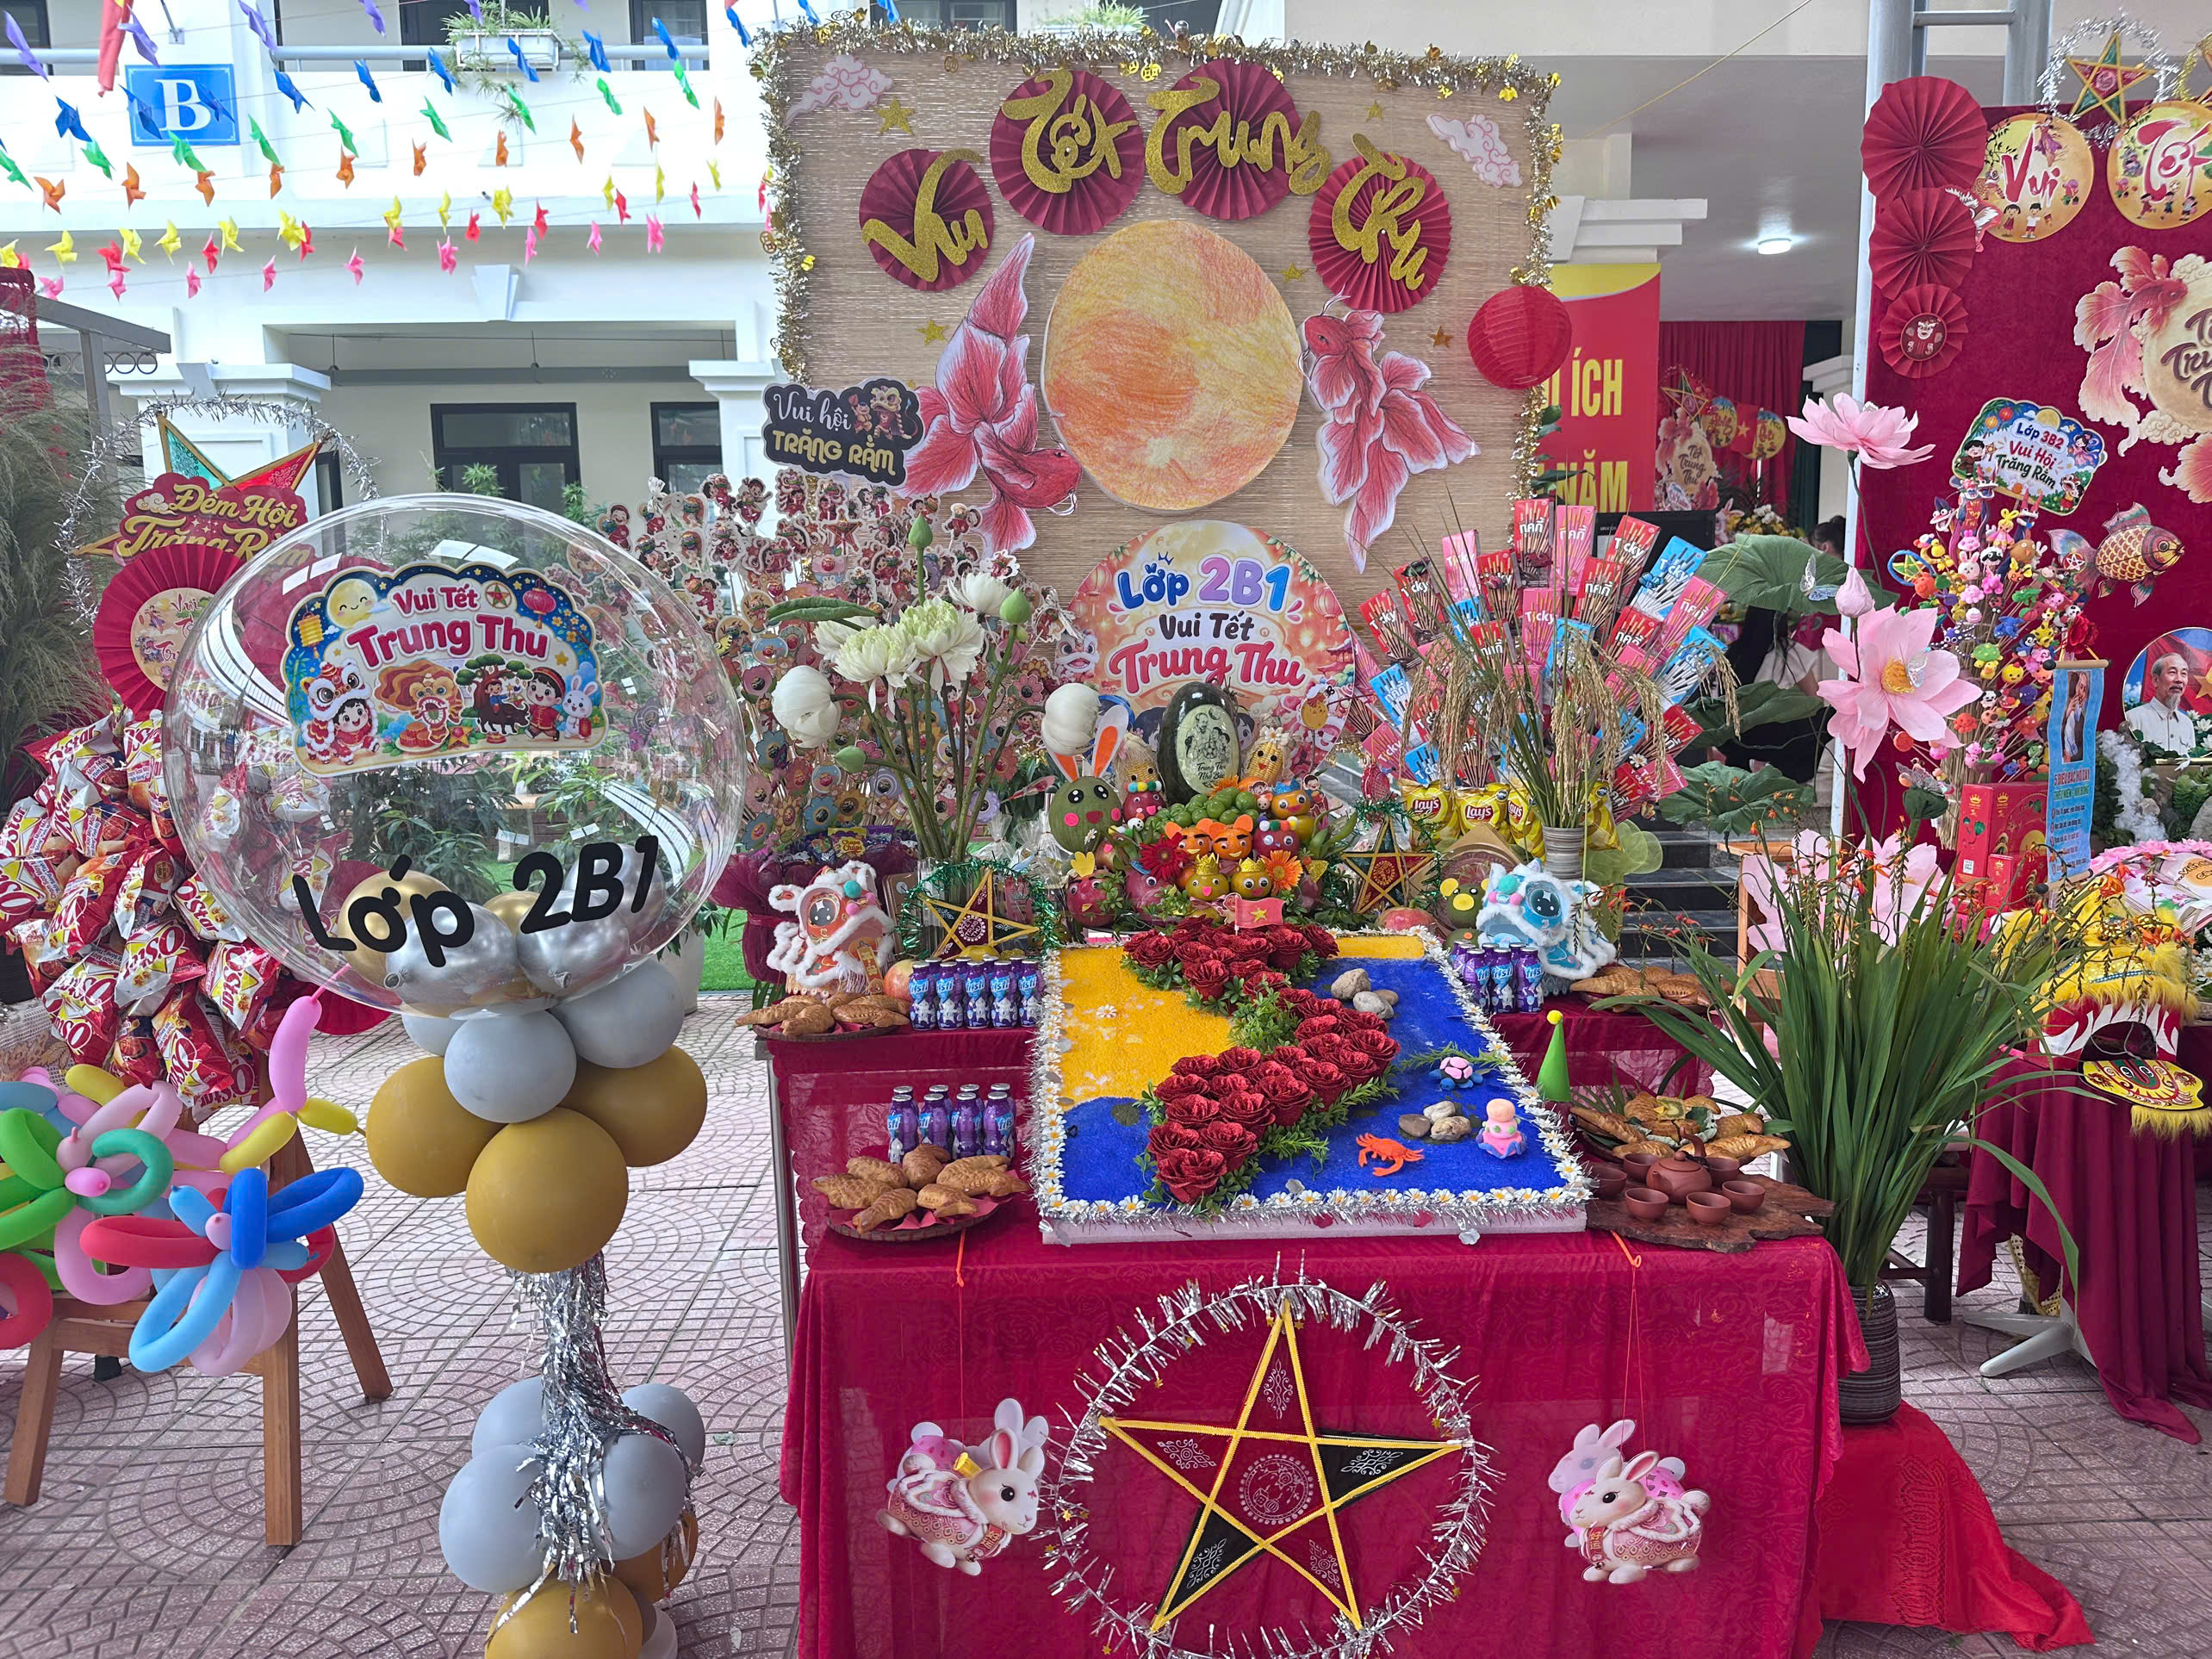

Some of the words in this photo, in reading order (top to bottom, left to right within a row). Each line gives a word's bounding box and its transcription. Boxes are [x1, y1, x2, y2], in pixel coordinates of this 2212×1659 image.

[155, 78, 212, 132] B
[1002, 69, 1138, 194] Tết
[1146, 76, 1333, 195] Trung
[1333, 133, 1428, 290] Thu
[2001, 124, 2061, 208] Vui
[1570, 346, 1623, 418] ÍCH
[2160, 342, 2212, 382] Tru
[774, 391, 814, 423] Vui
[820, 398, 852, 432] hội
[773, 428, 842, 464] TRĂNG
[848, 435, 896, 475] RẰM
[2010, 440, 2034, 457] Vui
[2035, 448, 2057, 469] Hội
[2016, 422, 2040, 440] Lớp
[2041, 431, 2064, 449] 3B2
[1556, 449, 1628, 514] NĂM
[1679, 454, 1706, 476] Trung
[1682, 469, 1698, 485] Thu
[1996, 454, 2031, 477] Trăng
[2032, 465, 2055, 488] Rằm
[169, 482, 240, 518] Đêm
[239, 495, 298, 529] Hội
[171, 593, 200, 612] Vui
[393, 587, 437, 616] Vui
[439, 583, 480, 610] Tết
[1118, 562, 1189, 610] Lớp
[1199, 556, 1289, 611] 2B1
[347, 619, 472, 668] Trung
[475, 614, 550, 658] Thu
[1159, 612, 1201, 640] Vui
[1209, 610, 1254, 641] Tết
[1109, 638, 1233, 693] Trung
[1234, 641, 1305, 687] Thu
[1414, 798, 1439, 813] Lay's
[1466, 805, 1492, 820] Lay's
[843, 844, 863, 854] Chups
[293, 854, 475, 967] Lớp
[513, 836, 659, 935] 2B1
